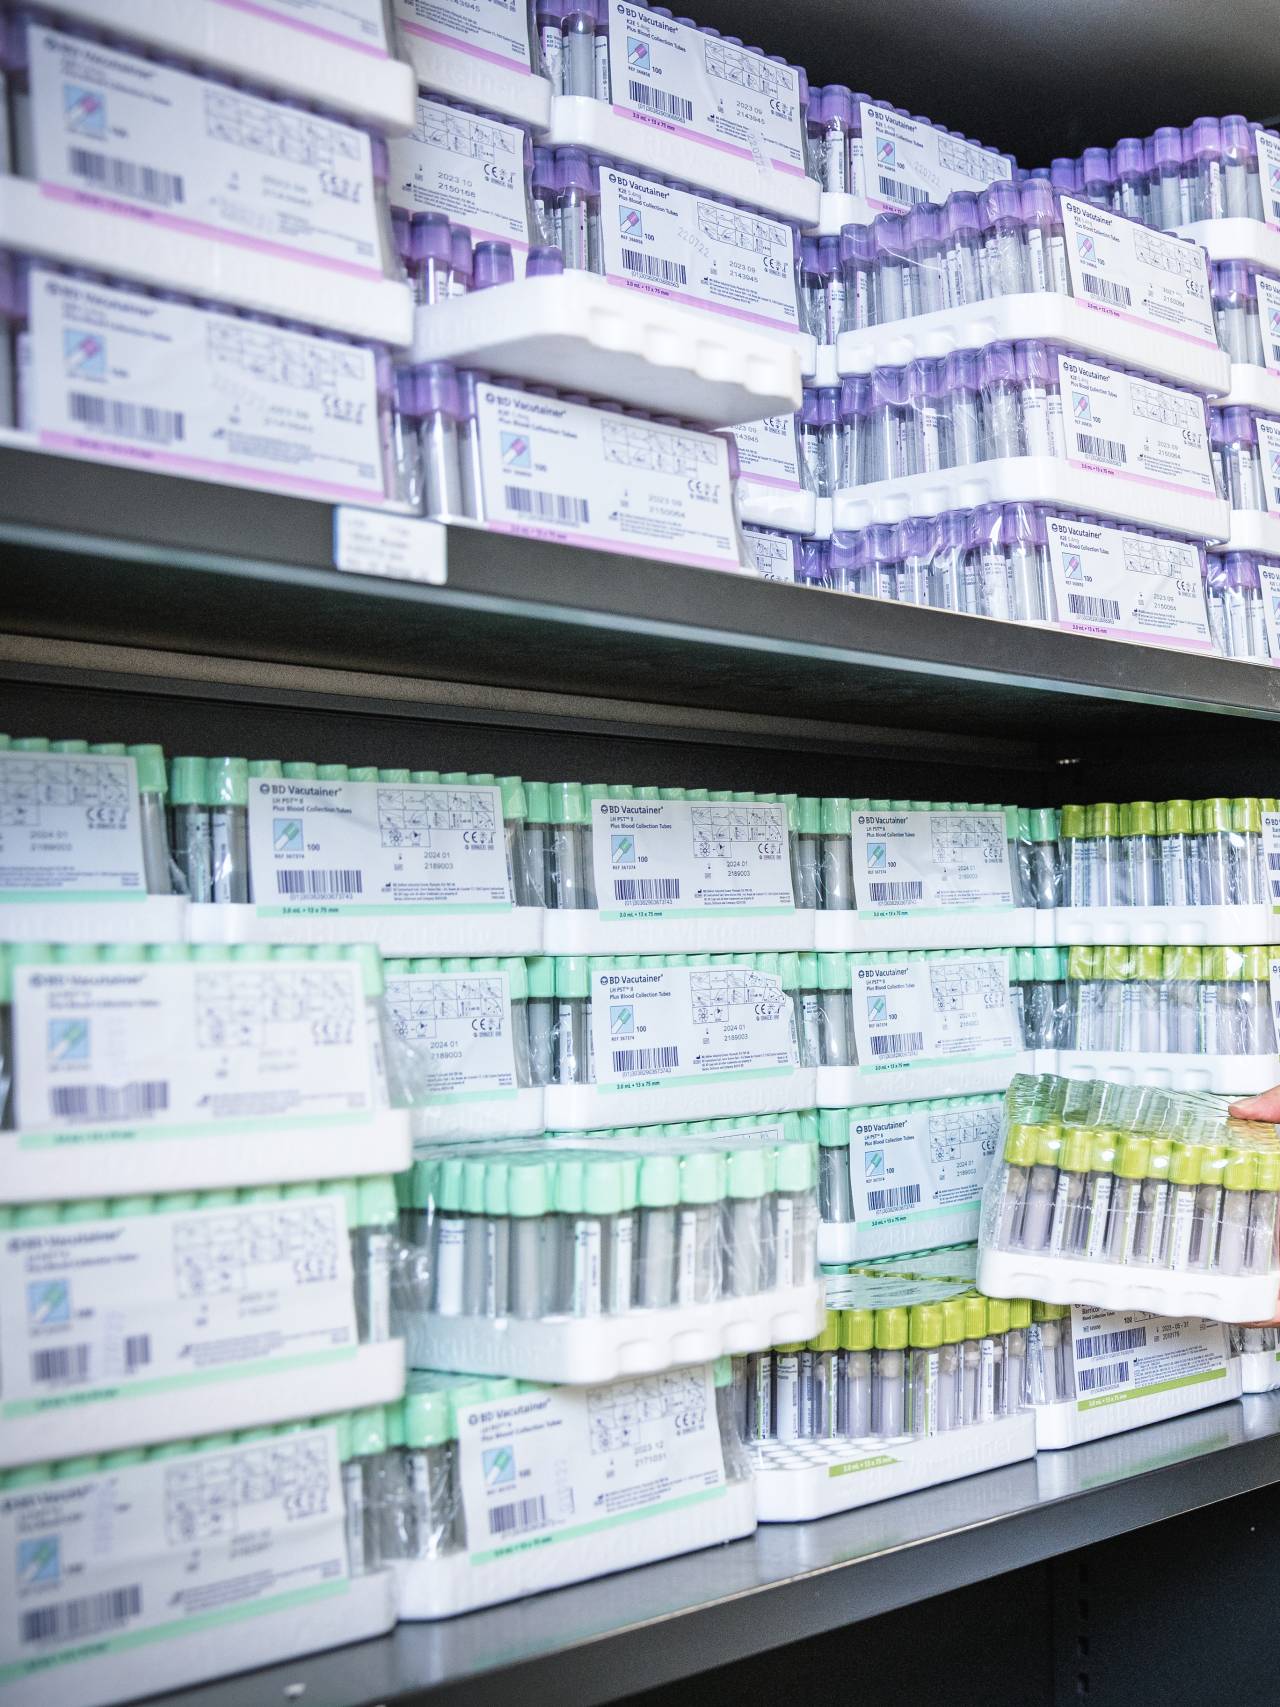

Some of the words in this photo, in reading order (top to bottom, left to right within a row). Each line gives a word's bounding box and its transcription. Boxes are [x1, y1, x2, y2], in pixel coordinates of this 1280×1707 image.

[626, 8, 636, 18] BD
[652, 67, 662, 75] 100
[736, 101, 753, 112] 2023
[754, 107, 762, 115] 09
[874, 112, 883, 121] BD
[438, 172, 459, 183] 2023
[463, 179, 472, 187] 10
[618, 177, 627, 186] BD
[1073, 205, 1081, 216] BD
[645, 233, 654, 241] 100
[677, 227, 709, 258] 220722
[730, 261, 745, 270] 2023
[1069, 364, 1077, 373] BD
[1058, 525, 1067, 533] BD
[272, 785, 286, 795] BD
[609, 806, 620, 814] BD
[424, 862, 453, 870] 2189003
[610, 976, 620, 984] BD
[481, 1411, 494, 1422] BD
